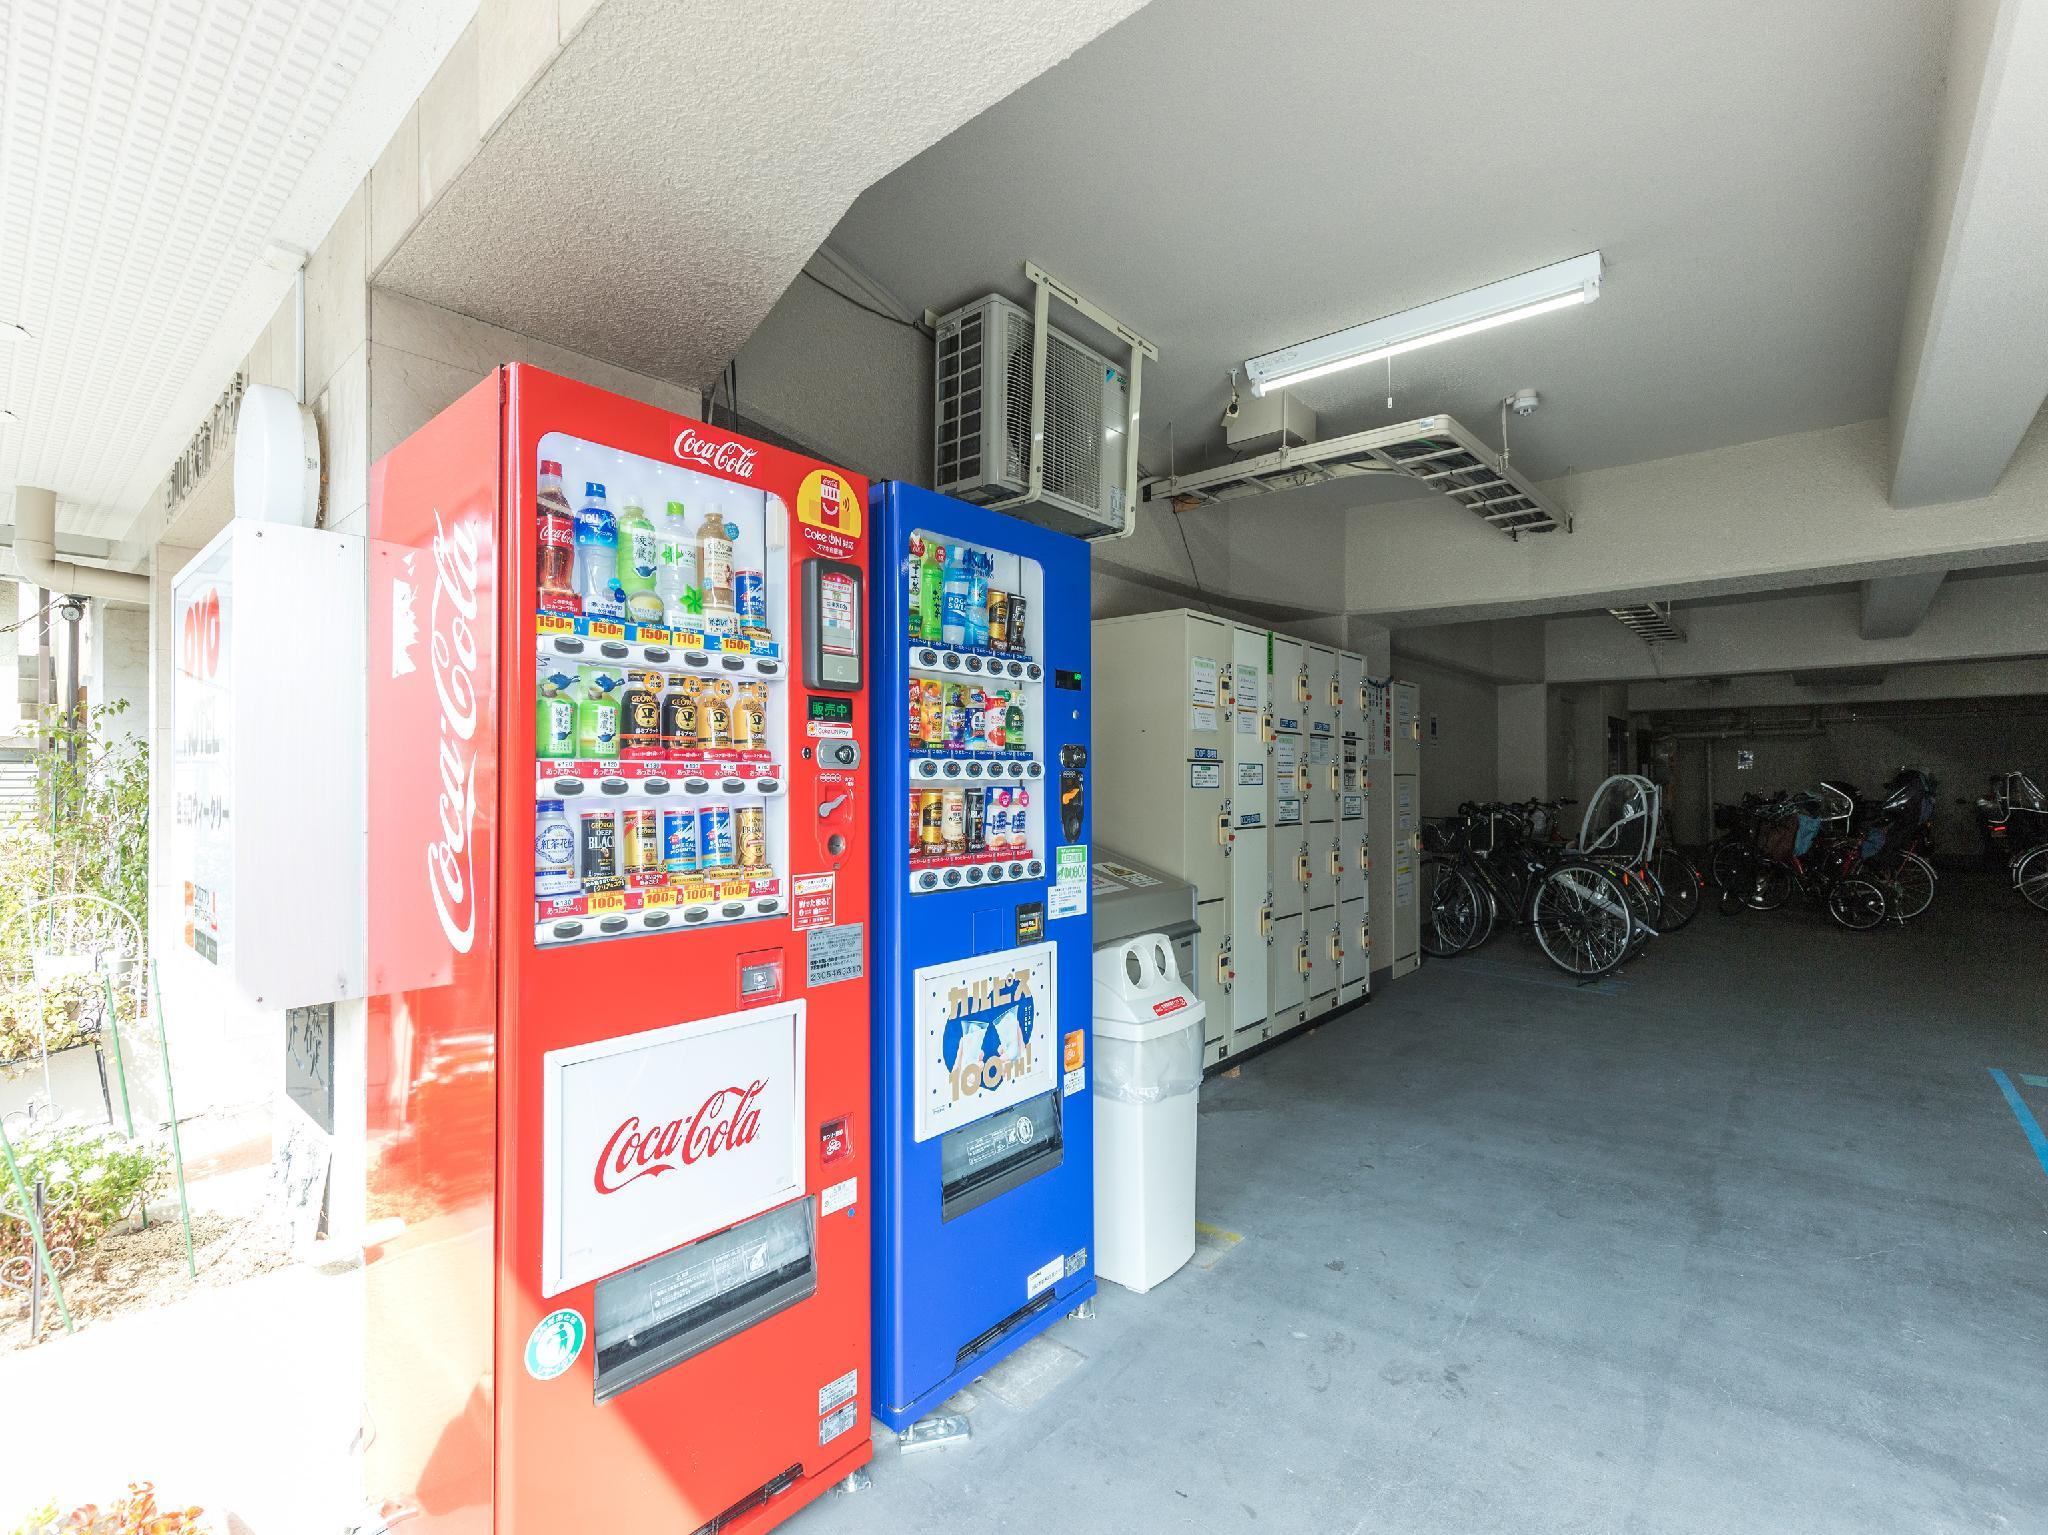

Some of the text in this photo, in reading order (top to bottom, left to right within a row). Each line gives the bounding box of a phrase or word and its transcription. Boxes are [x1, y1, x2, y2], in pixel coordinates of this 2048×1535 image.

[674, 428, 759, 478] Coca-Cola
[805, 528, 828, 542] Coke
[537, 615, 573, 630] 150円
[592, 621, 624, 636] 150円
[184, 587, 221, 681] OYO
[639, 628, 669, 641] 150円
[676, 632, 701, 645] 110円
[723, 638, 749, 651] 150円
[812, 701, 848, 718] 販売中
[427, 507, 478, 954] Coca-Cola
[686, 889, 713, 901] 100円
[722, 885, 748, 897] 100円
[591, 897, 624, 910] 100円
[646, 892, 676, 905] 100円
[948, 968, 1032, 1021] カルピス
[594, 1076, 770, 1195] Coca-Cola
